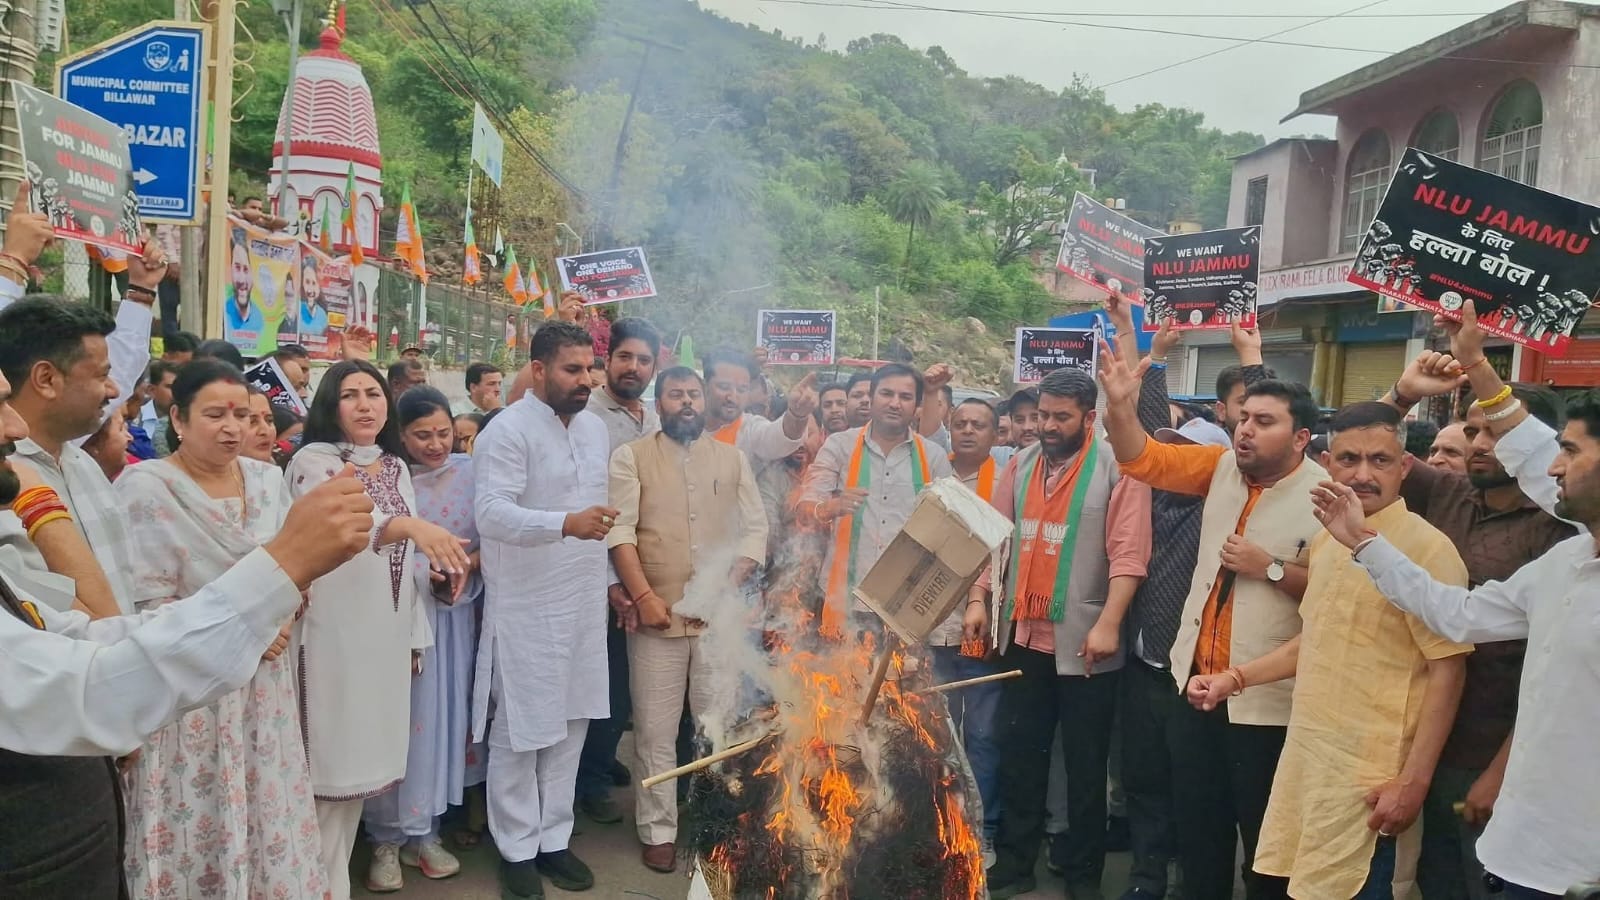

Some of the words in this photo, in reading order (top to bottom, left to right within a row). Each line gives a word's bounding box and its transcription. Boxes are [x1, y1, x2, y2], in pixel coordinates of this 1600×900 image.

[72, 75, 127, 91] MUNICIPAL
[129, 79, 190, 94] COMMITTEE
[104, 91, 155, 106] BILLAWAR
[42, 126, 75, 151] FOR
[80, 141, 122, 170] JAMMU
[124, 124, 187, 149] BAZAR
[67, 170, 115, 198] JAMMU
[1078, 217, 1112, 242] NLU
[1413, 183, 1473, 216] NLU
[1476, 205, 1591, 255] JAMMU
[1105, 220, 1120, 234] WE
[1122, 229, 1145, 246] WAN
[1461, 222, 1480, 239] के
[1480, 229, 1516, 252] लिए
[1177, 248, 1192, 258] WE
[1194, 245, 1224, 256] WANT
[1409, 229, 1477, 266] हल्ला
[1479, 252, 1536, 287] बोल
[1537, 274, 1551, 293] !
[580, 262, 597, 271] ONE
[600, 259, 626, 267] VOICE
[597, 264, 632, 273] DEMAND
[1153, 260, 1184, 276] NLU
[1188, 254, 1250, 273] JAMMU
[1428, 273, 1494, 301] #NLU4Jammu
[1379, 286, 1416, 305] BHARATIYA
[1416, 300, 1444, 316] JANATA
[1494, 327, 1529, 345] KASHMIR
[768, 326, 787, 334] NLU
[791, 326, 827, 334] JAMMU
[1029, 340, 1050, 349] NLU
[1050, 340, 1086, 350] JAMMU
